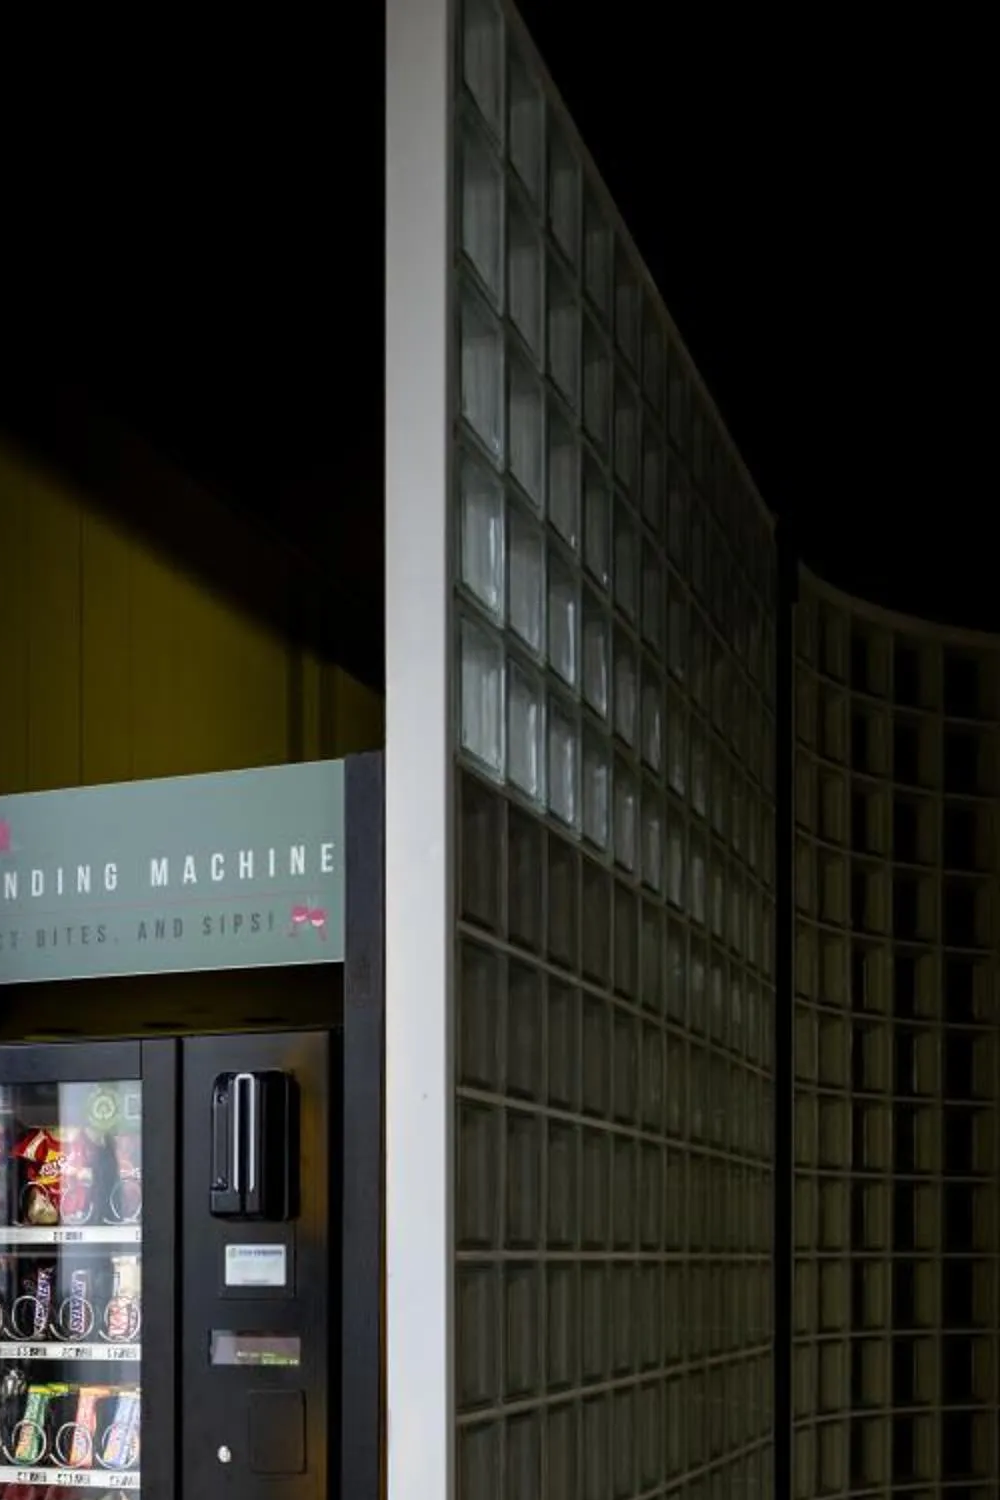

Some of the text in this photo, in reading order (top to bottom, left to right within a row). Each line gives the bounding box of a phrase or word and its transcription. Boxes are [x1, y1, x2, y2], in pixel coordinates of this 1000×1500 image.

[151, 842, 334, 887] MACHINE
[138, 917, 183, 940] AND
[202, 910, 274, 936] SIPS!
